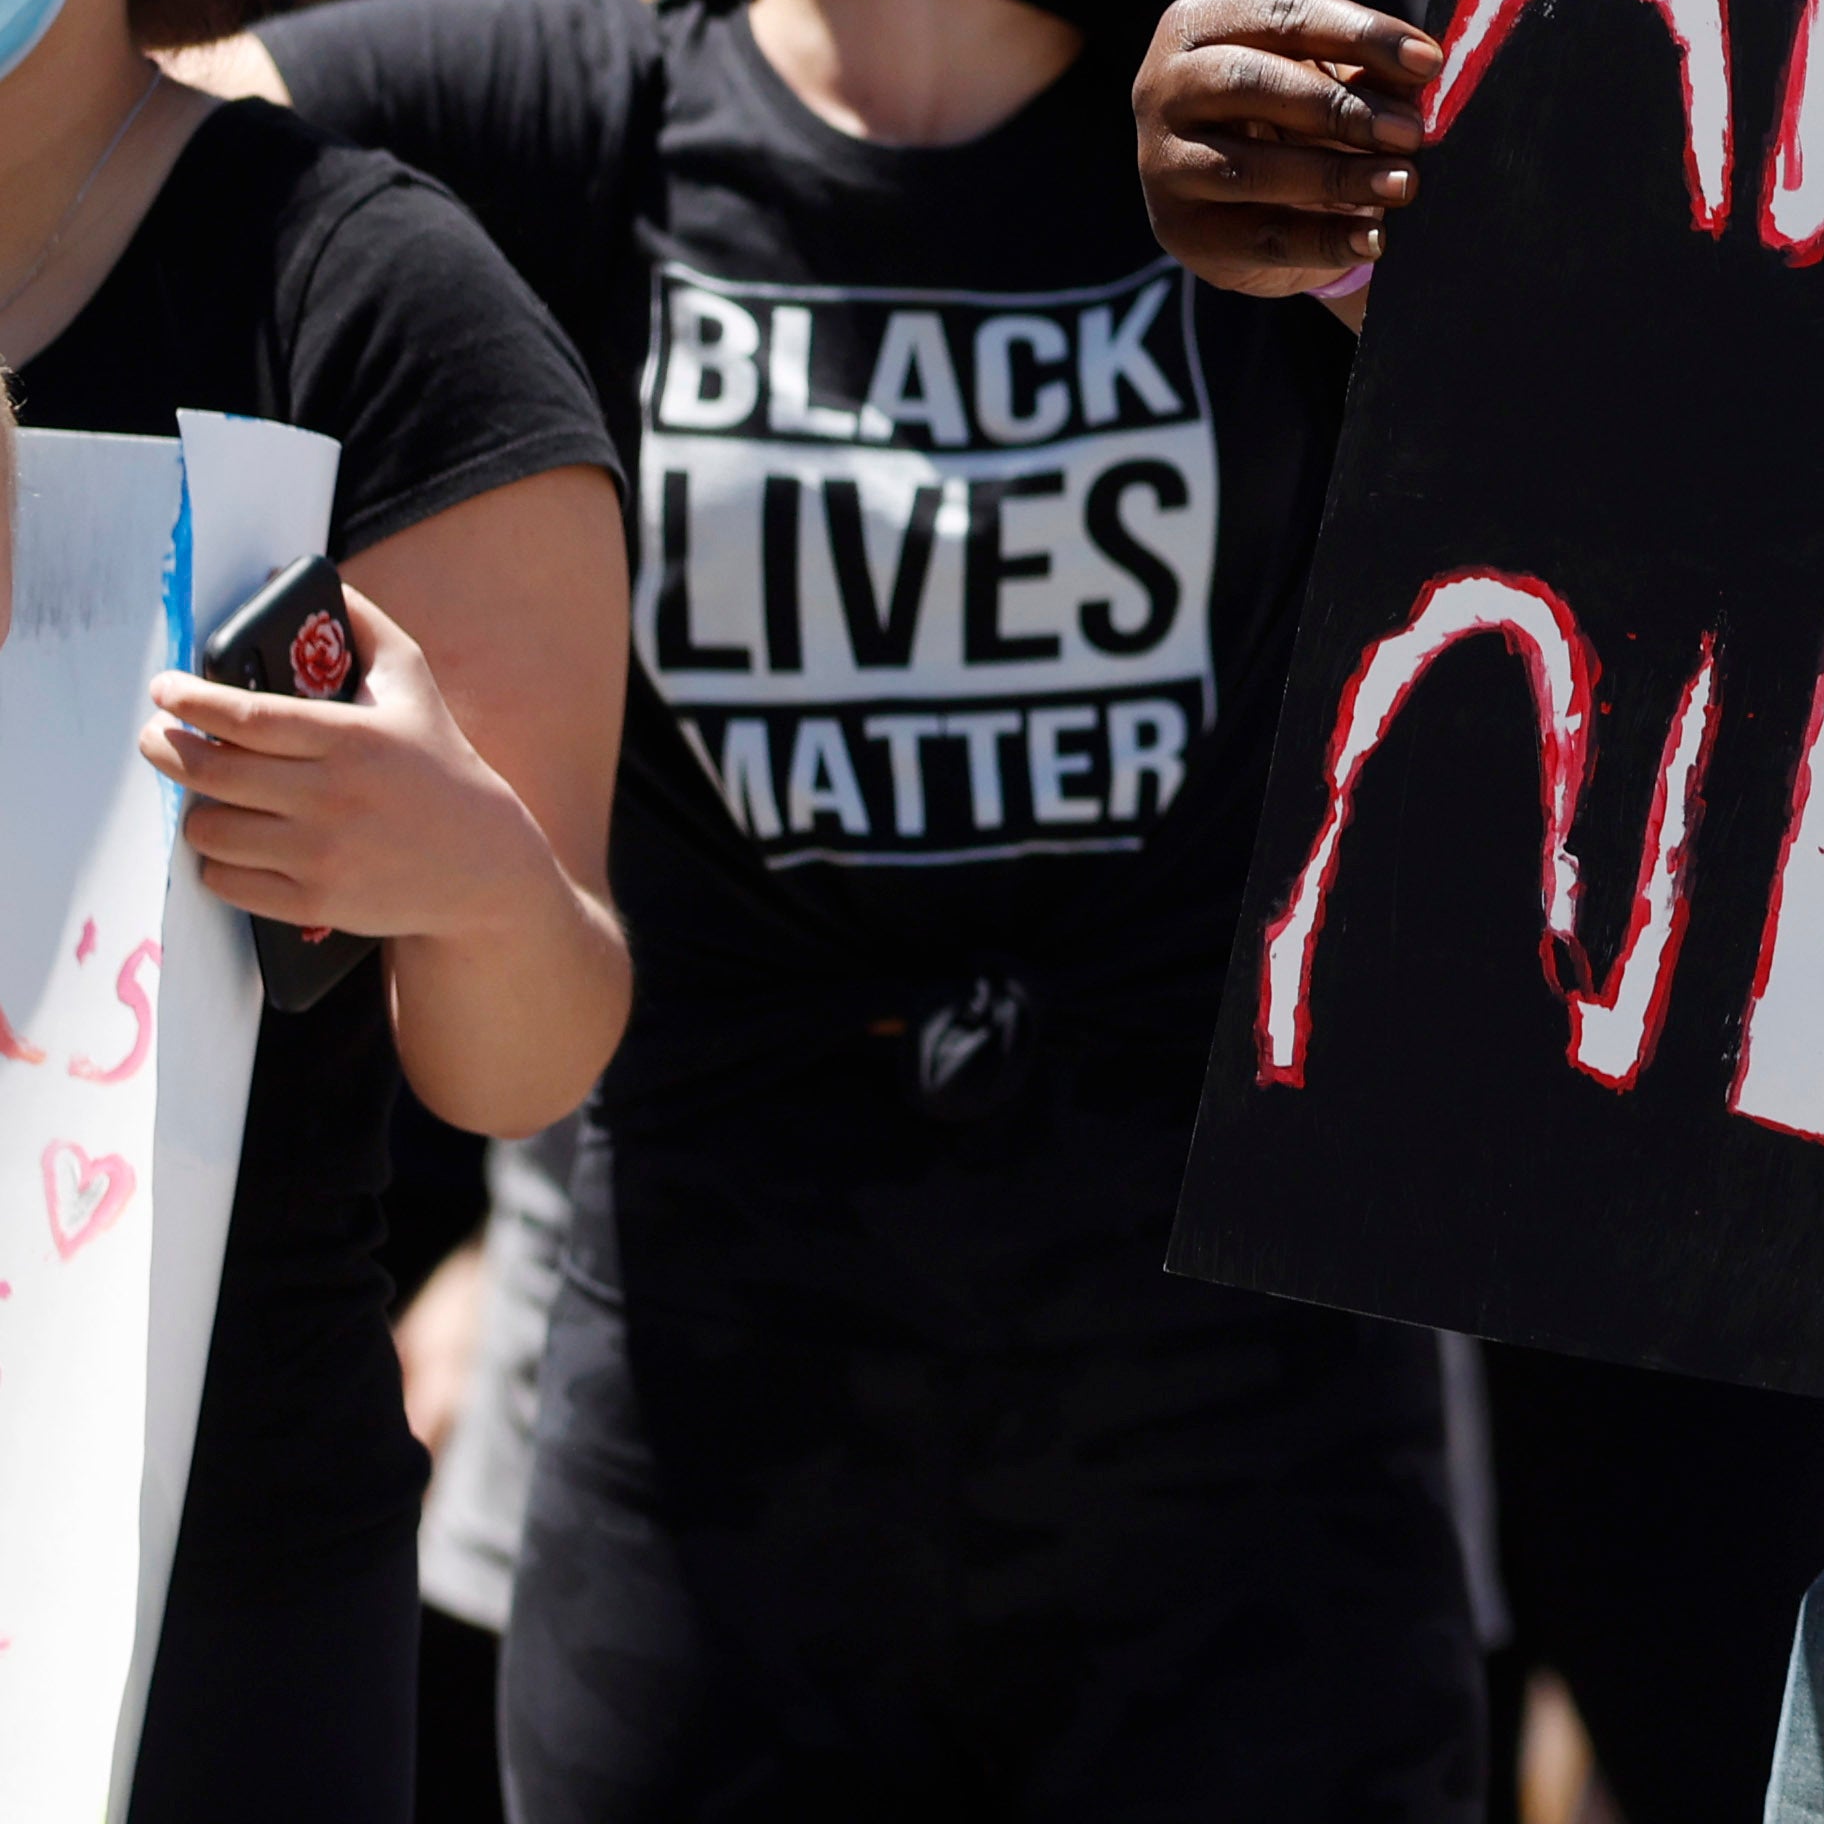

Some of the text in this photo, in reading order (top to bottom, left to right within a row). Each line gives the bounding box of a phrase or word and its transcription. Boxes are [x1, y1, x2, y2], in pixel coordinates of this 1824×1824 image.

[656, 278, 1184, 446] BLACK
[654, 458, 1192, 675] LIVES
[676, 698, 1190, 841] MATTER
